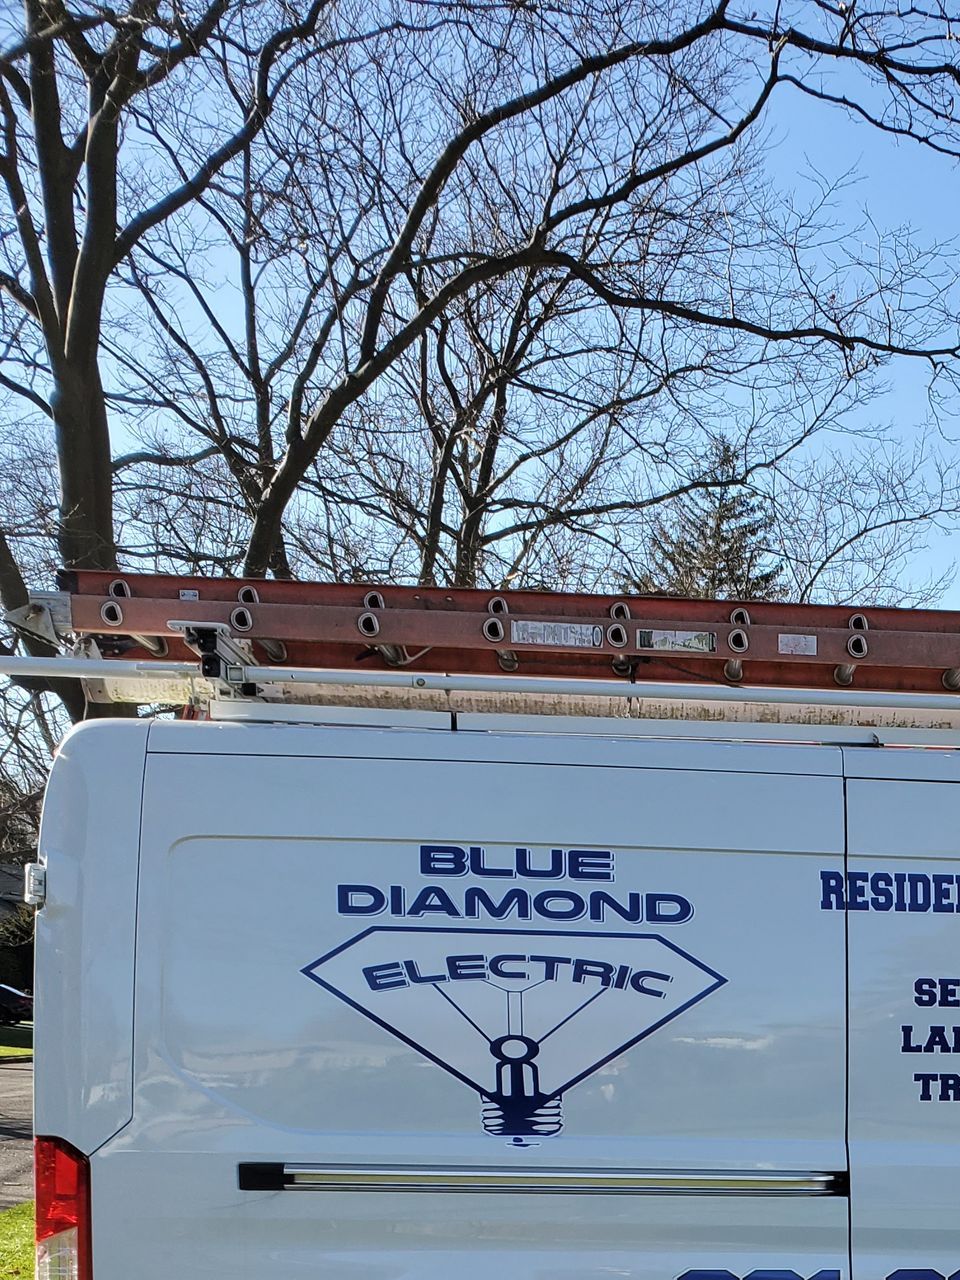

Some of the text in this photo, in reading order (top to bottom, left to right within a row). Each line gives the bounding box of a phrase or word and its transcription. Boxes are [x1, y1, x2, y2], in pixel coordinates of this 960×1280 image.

[419, 845, 615, 882] BLUE
[337, 885, 694, 924] DIAMOND
[362, 954, 673, 999] ELECTRIC
